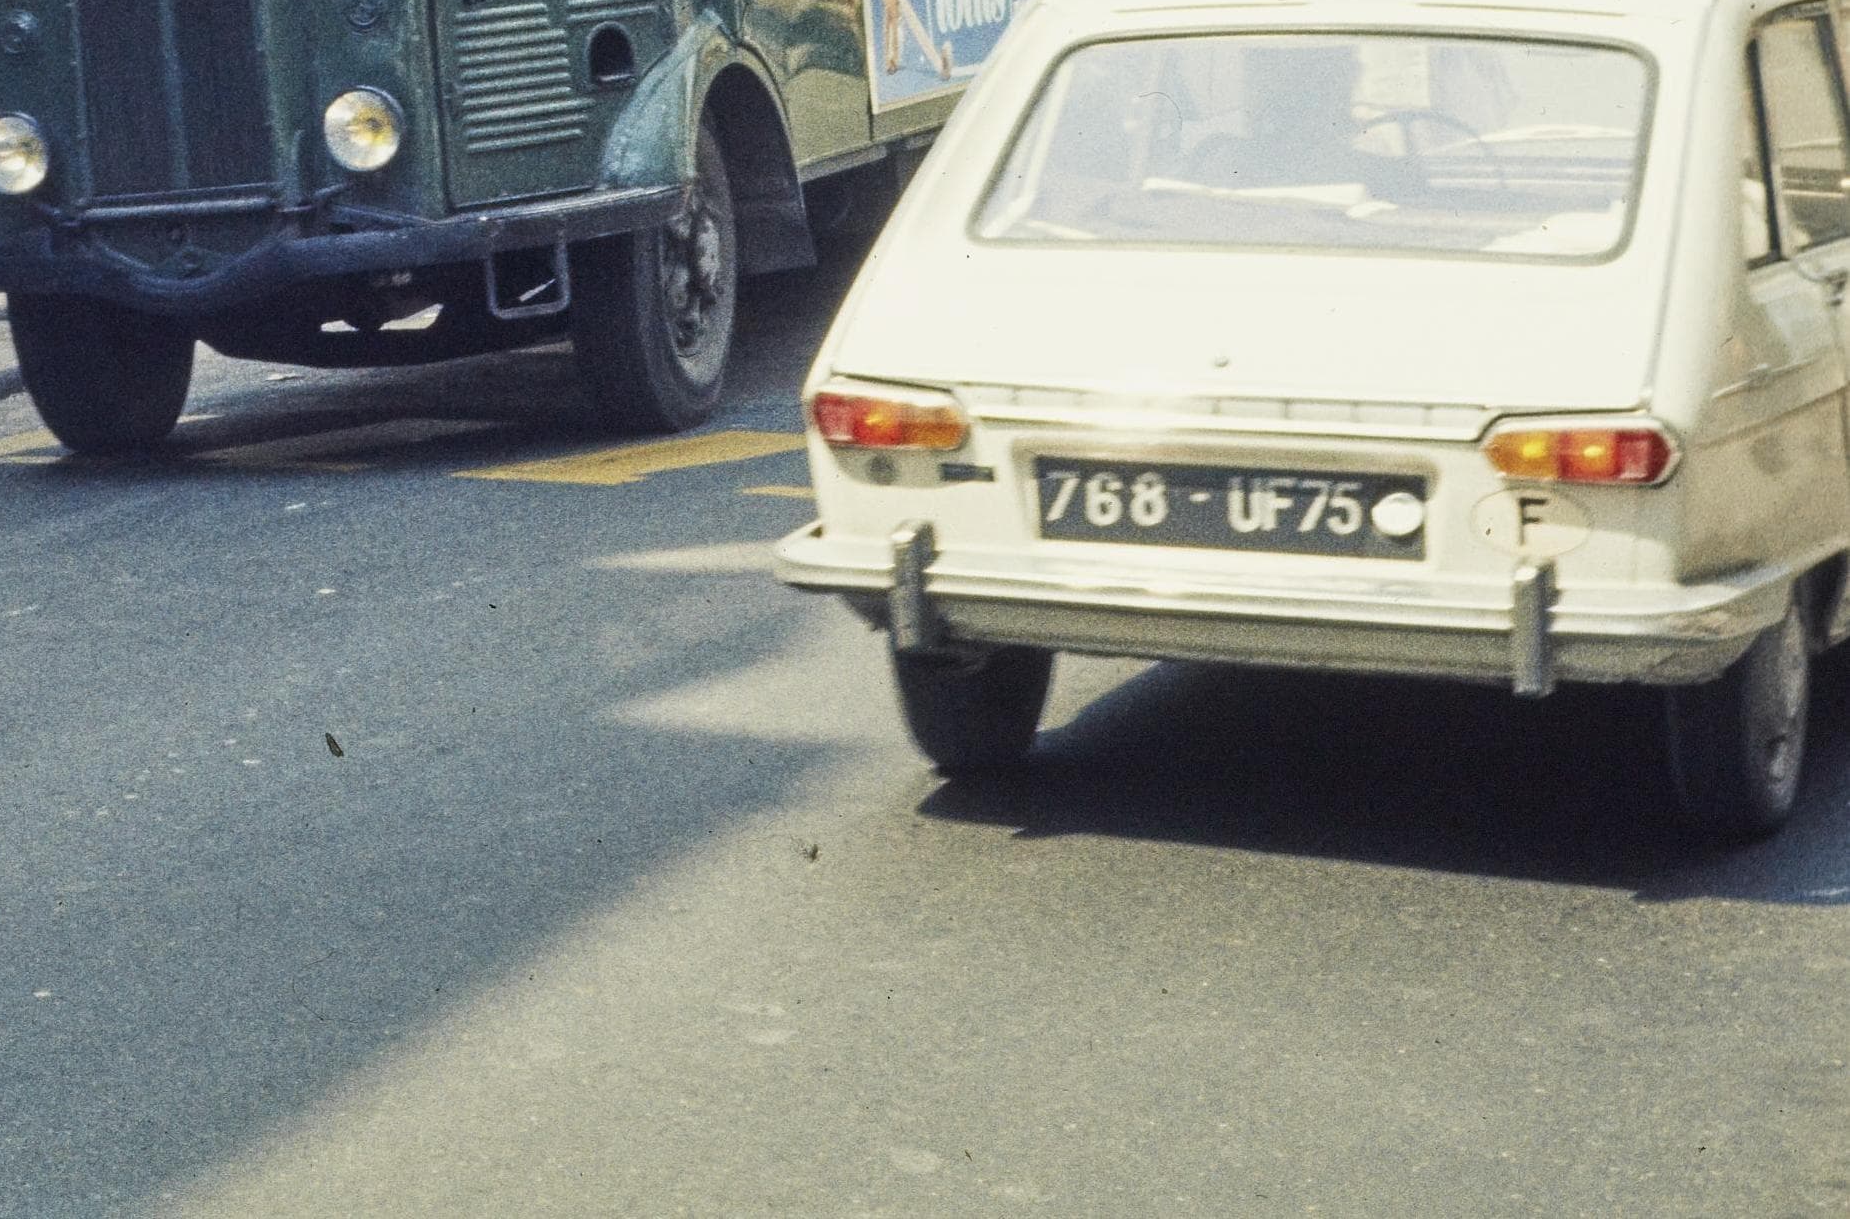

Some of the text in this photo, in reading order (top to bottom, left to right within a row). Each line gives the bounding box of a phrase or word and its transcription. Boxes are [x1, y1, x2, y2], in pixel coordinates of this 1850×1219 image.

[1045, 469, 1169, 528] 768
[1226, 476, 1363, 536] UF75
[1518, 496, 1549, 547] F
